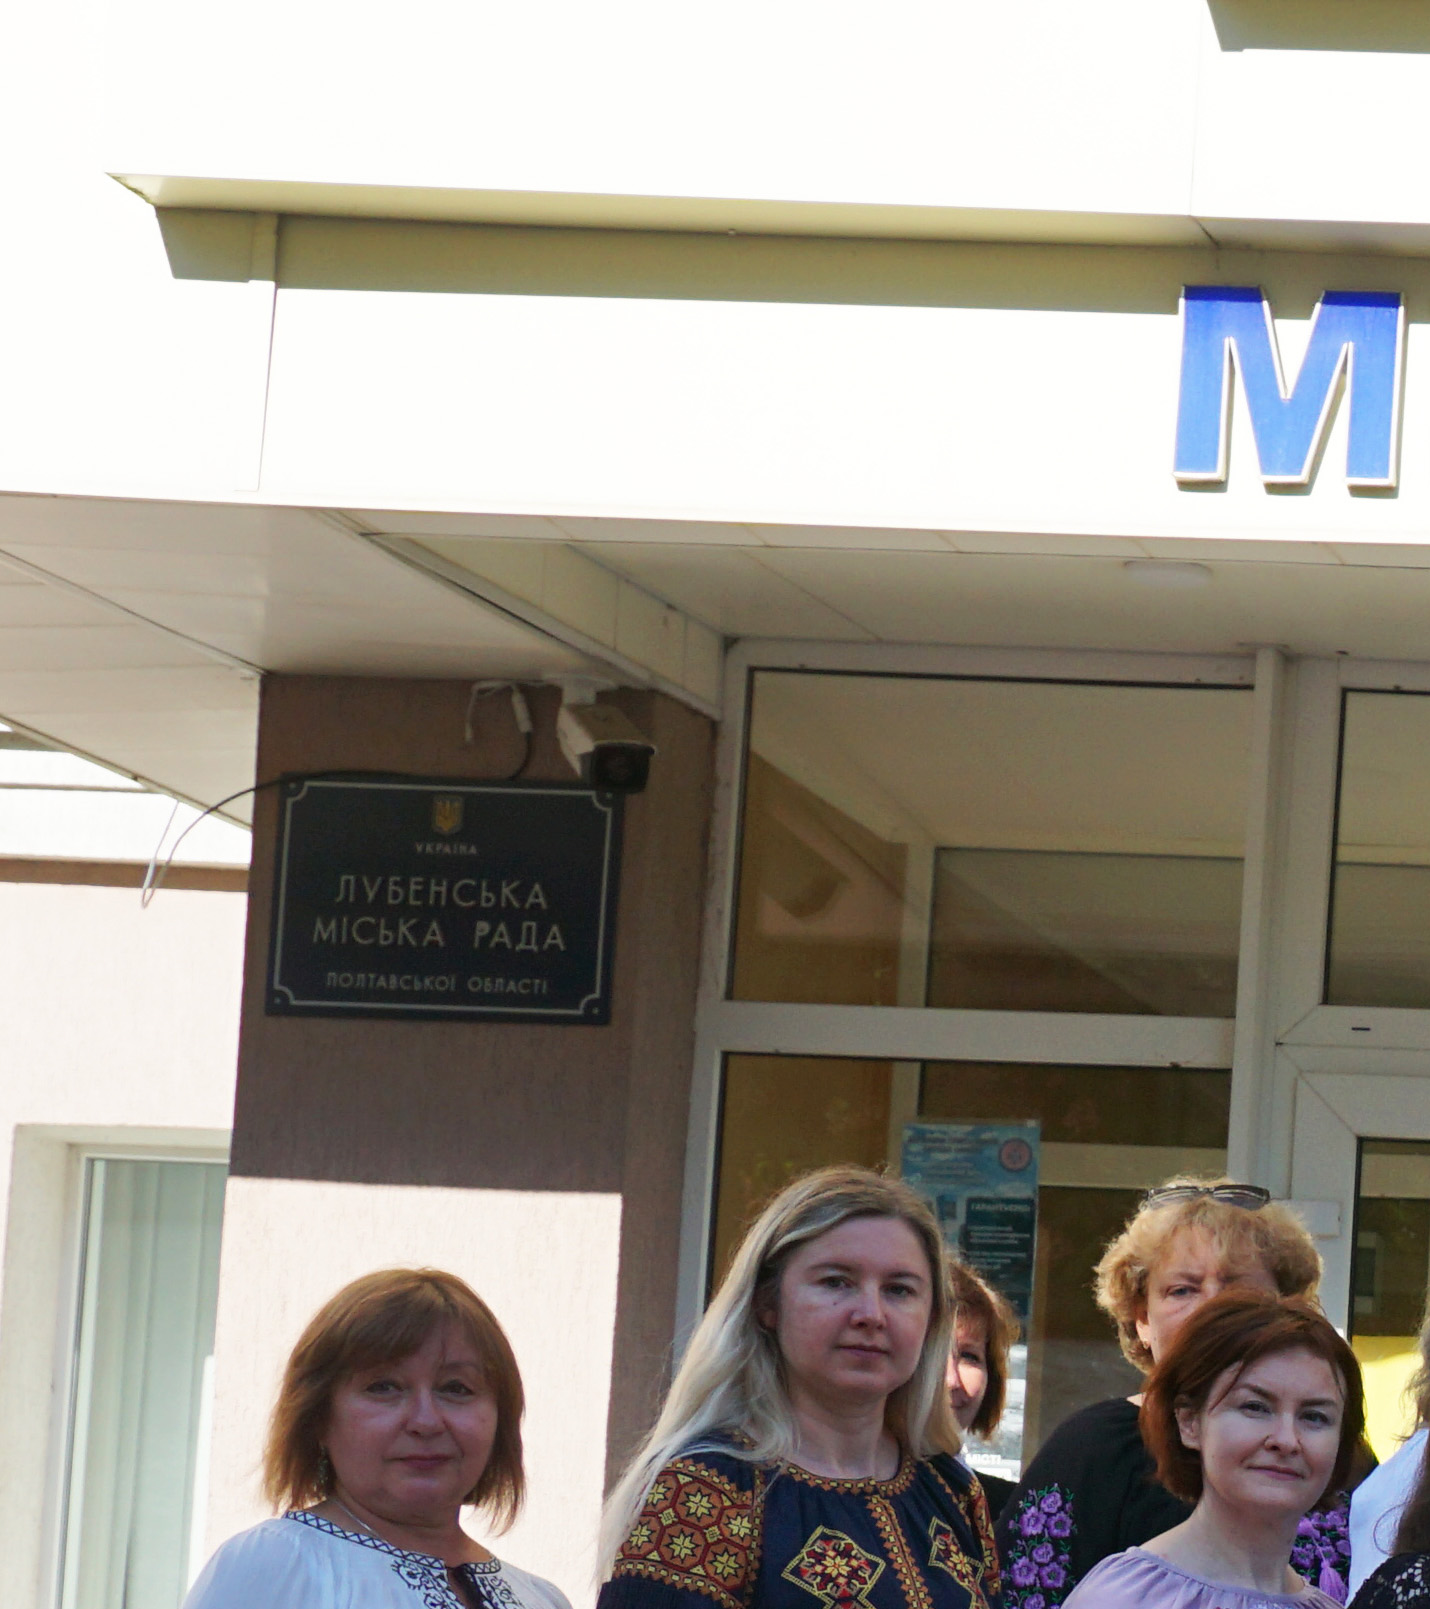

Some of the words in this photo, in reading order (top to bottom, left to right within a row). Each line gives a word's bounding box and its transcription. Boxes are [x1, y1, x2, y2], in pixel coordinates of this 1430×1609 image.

[415, 842, 478, 856] УКРАЇНА
[336, 875, 549, 910] ЛУБЕНСЬКА
[313, 917, 446, 948] МІСЬКА
[473, 920, 566, 953] РАДА
[326, 971, 457, 992] ПОЛТАВСЬКОЇ
[467, 978, 549, 996] ОБЛАСТІ
